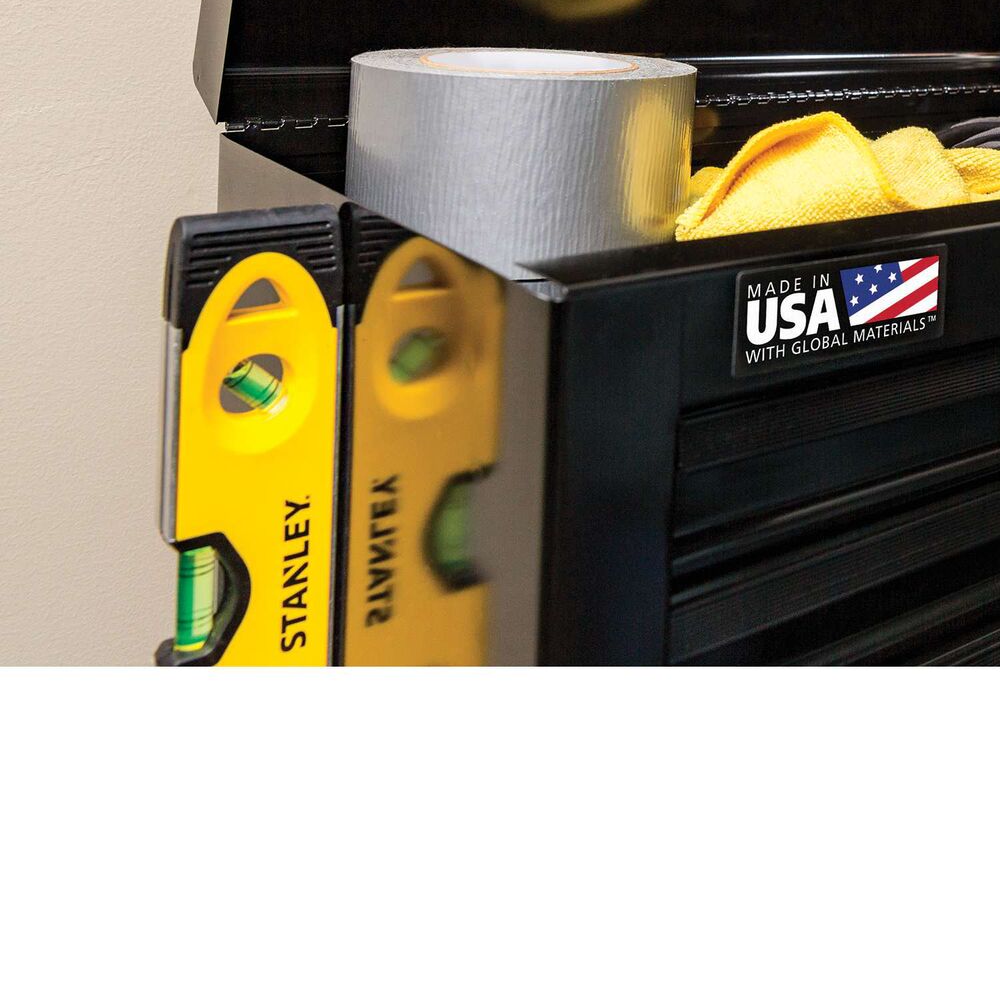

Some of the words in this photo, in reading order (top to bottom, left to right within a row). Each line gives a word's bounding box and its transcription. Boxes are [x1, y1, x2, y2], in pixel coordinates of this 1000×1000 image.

[747, 277, 802, 299] MADE
[812, 273, 830, 288] IN
[746, 287, 841, 346] USA
[745, 343, 786, 364] WITH
[791, 333, 848, 355] GLOBAL
[280, 498, 311, 652] STANLEY
